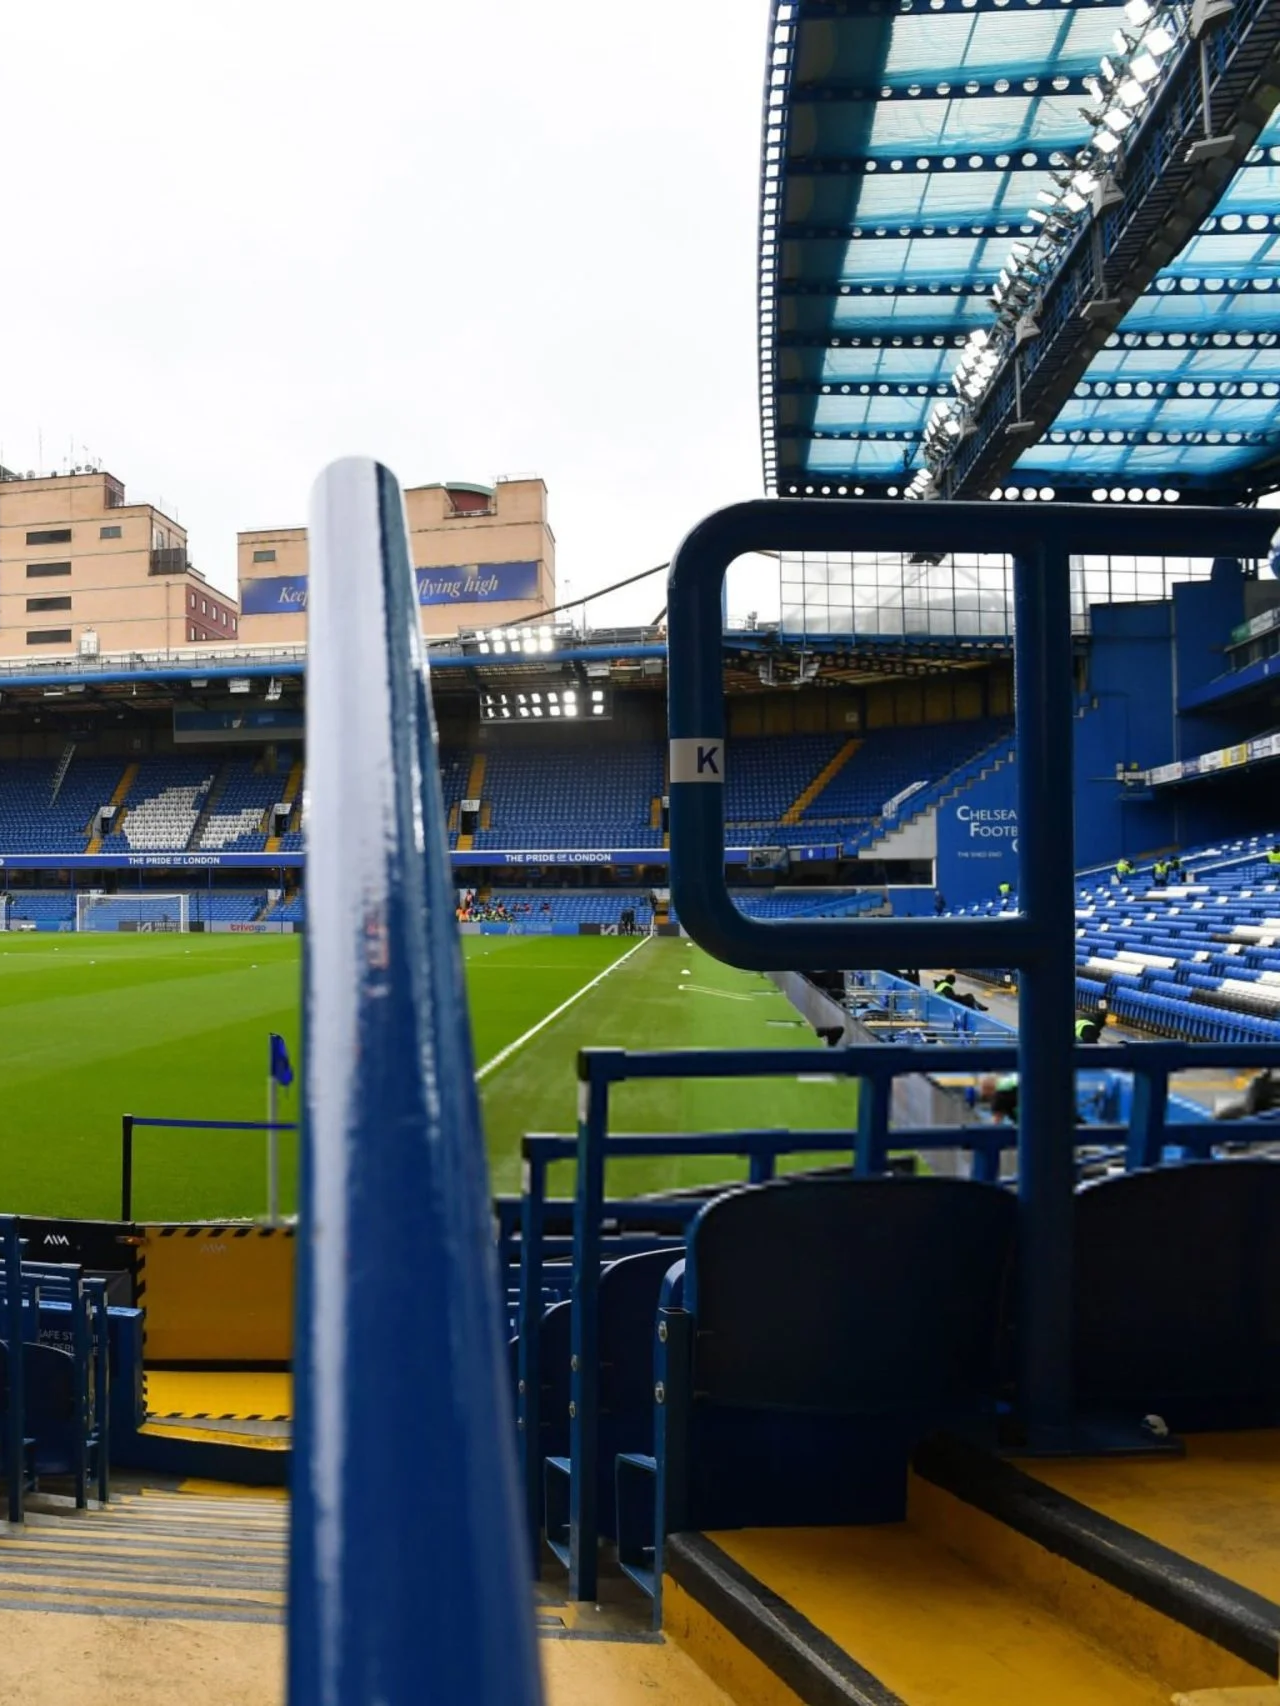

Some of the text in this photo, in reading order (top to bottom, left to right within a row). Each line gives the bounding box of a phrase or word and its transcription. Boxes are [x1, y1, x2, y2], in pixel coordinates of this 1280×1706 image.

[463, 574, 498, 596] high
[697, 746, 719, 774] K
[956, 805, 1018, 821] CHELSEA
[970, 822, 1018, 837] FOOTB
[128, 857, 144, 865] THE
[145, 857, 171, 865] PRIDE
[183, 856, 220, 865] LONDON
[505, 854, 524, 863] THE
[525, 854, 555, 863] PRIDE
[568, 853, 612, 862] LONDON
[230, 923, 267, 933] trivago
